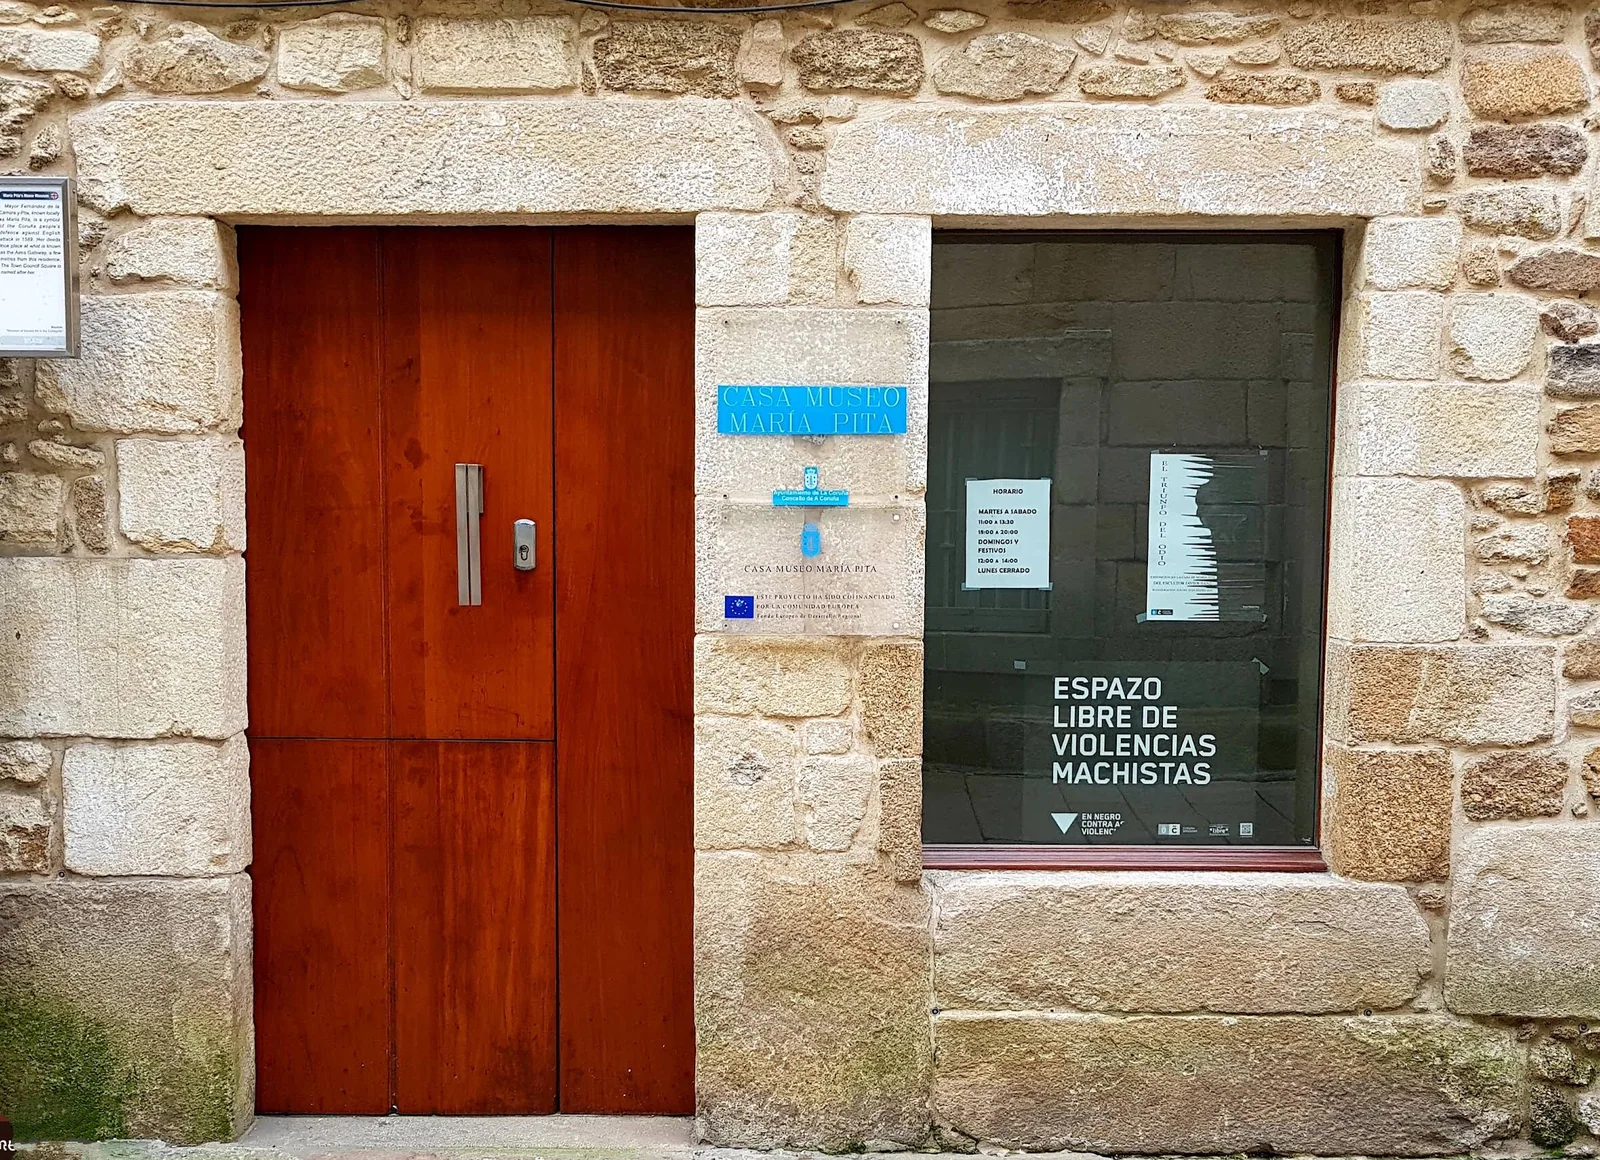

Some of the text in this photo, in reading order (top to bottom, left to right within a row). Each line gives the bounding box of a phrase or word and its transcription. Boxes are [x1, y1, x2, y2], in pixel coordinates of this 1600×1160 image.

[723, 387, 900, 407] CASA MUSEO
[730, 410, 893, 433] MARÍA PITA
[816, 564, 851, 572] MARÍA
[1054, 677, 1162, 700] ESPAZO
[1053, 706, 1178, 728] LIBRE DE
[1052, 734, 1216, 757] VIOLENCIAS
[1052, 762, 1211, 785] MACHISTAS
